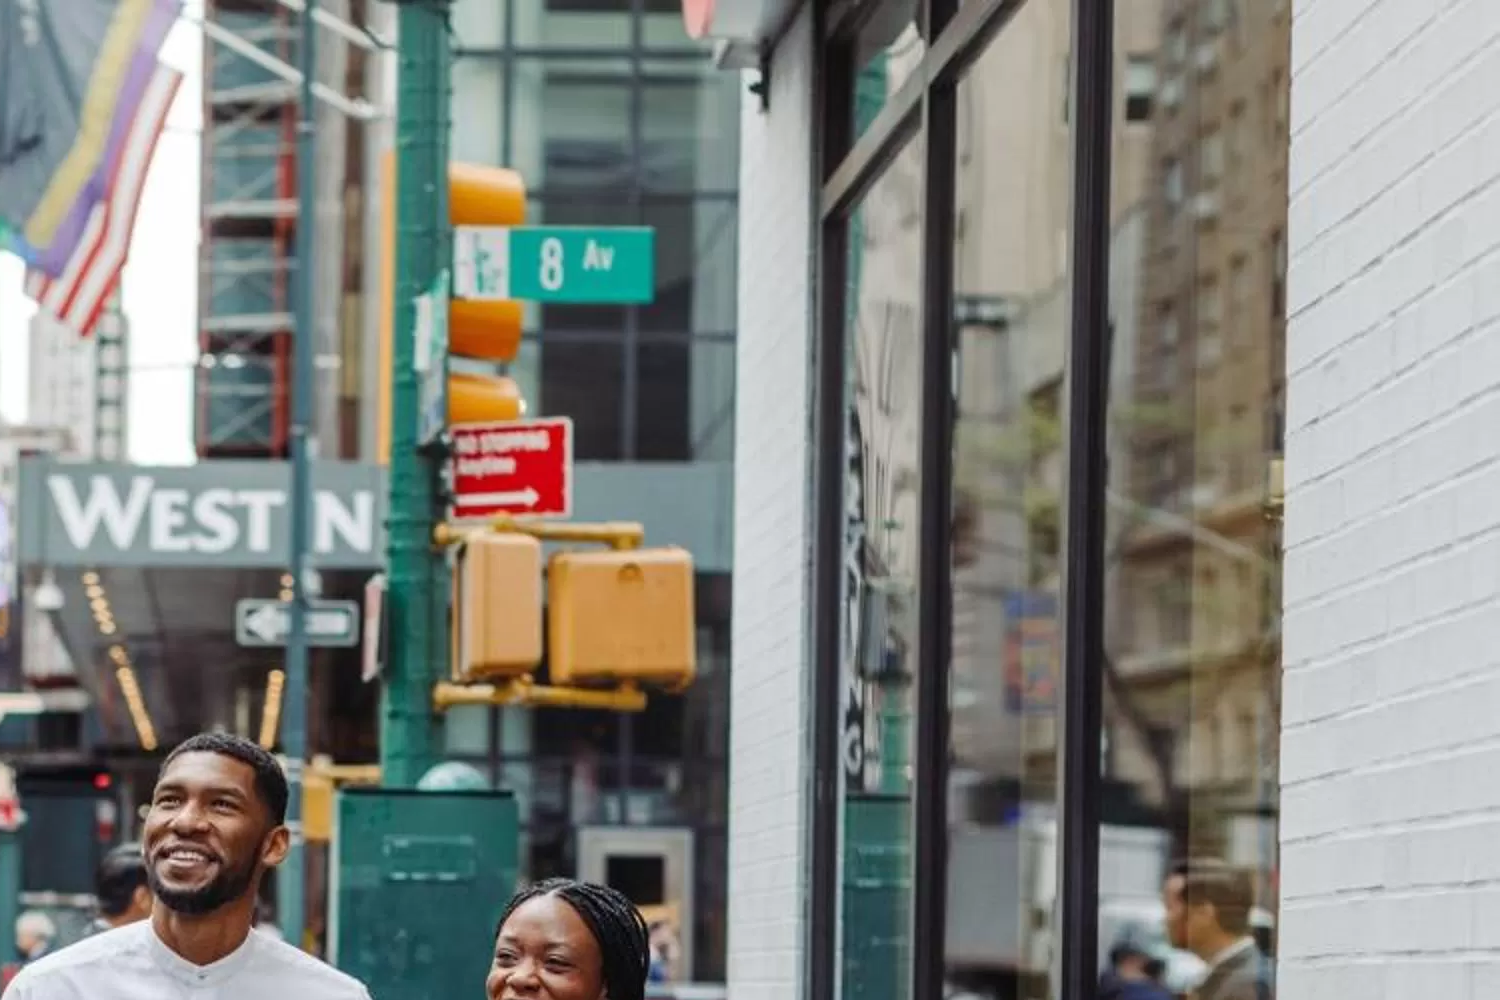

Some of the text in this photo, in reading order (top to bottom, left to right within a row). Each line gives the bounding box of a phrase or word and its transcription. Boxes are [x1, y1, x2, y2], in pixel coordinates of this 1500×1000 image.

[540, 236, 564, 291] 8
[582, 238, 615, 272] Av
[47, 474, 374, 553] WESTN
